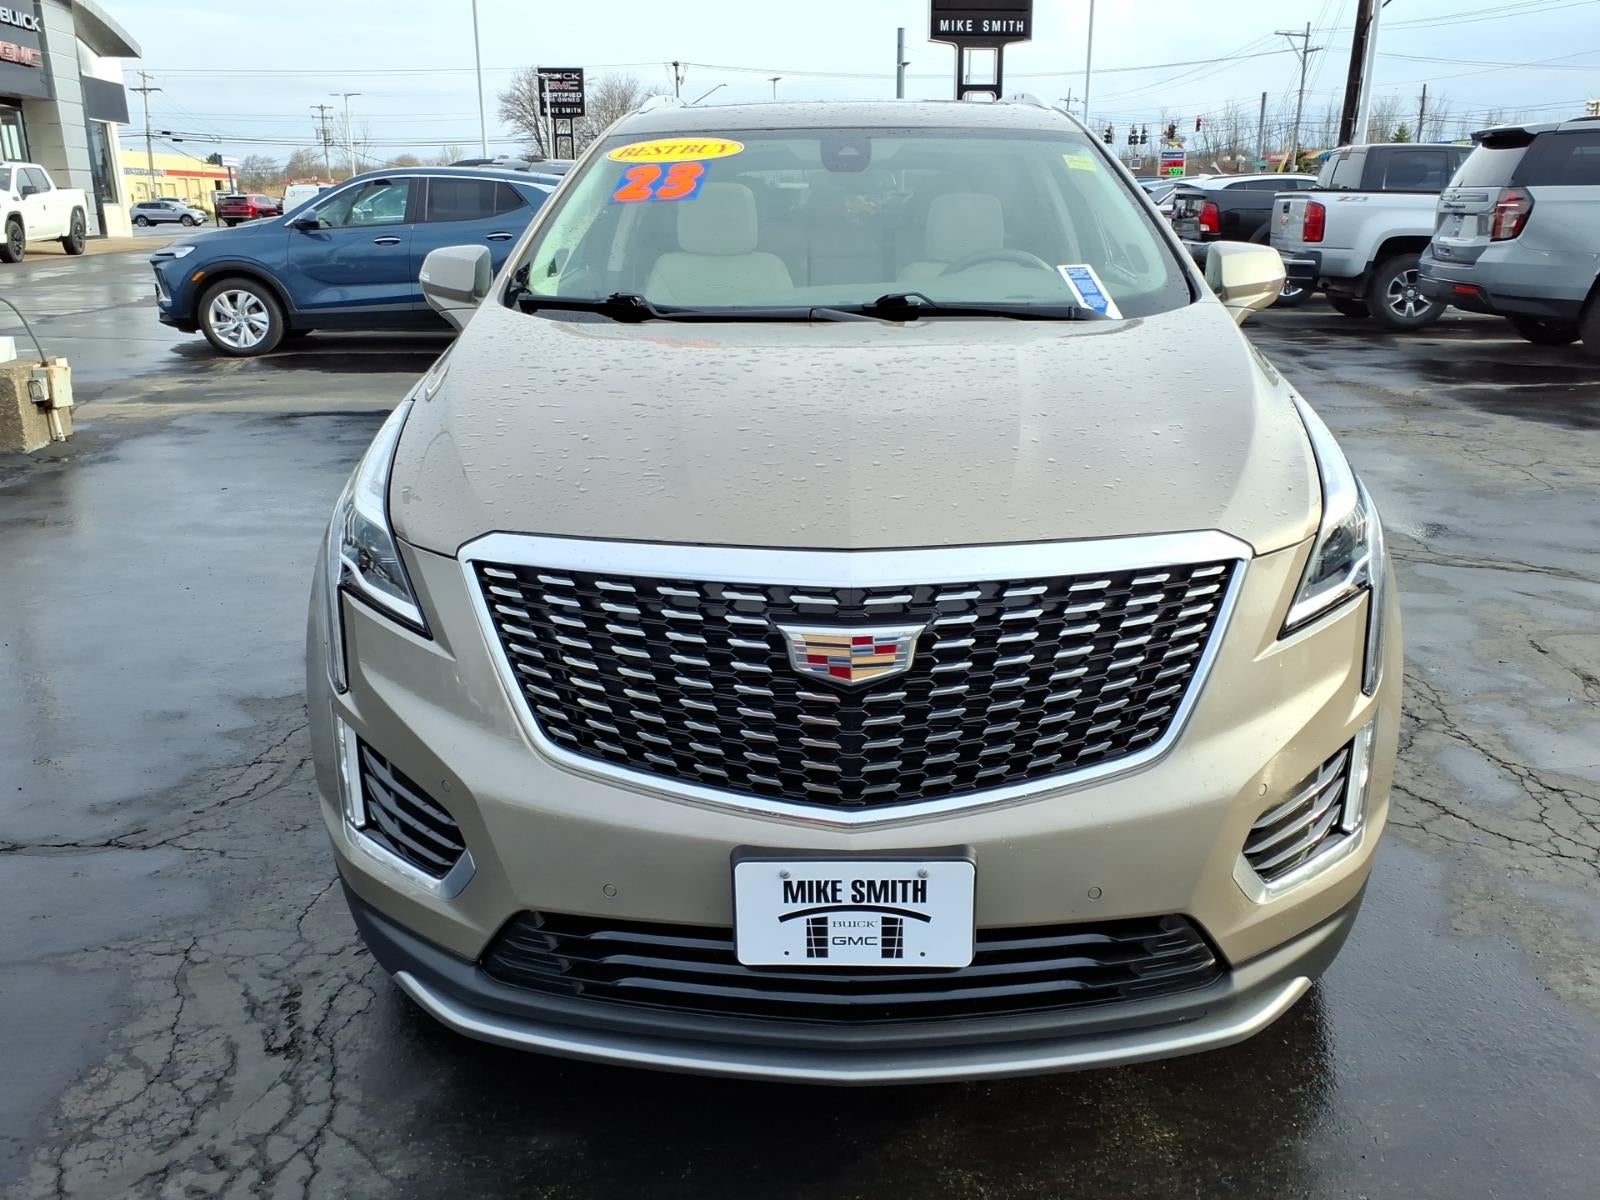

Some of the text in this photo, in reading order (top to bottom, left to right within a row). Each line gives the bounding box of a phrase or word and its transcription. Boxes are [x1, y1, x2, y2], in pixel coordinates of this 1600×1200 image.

[0, 6, 41, 32] BUICK
[940, 19, 1024, 32] MIKE SMITH
[0, 40, 42, 67] GMC
[613, 161, 705, 202] 23
[782, 879, 928, 904] MIKE SMITH
[832, 920, 876, 929] BUICK
[831, 936, 879, 946] GMC
